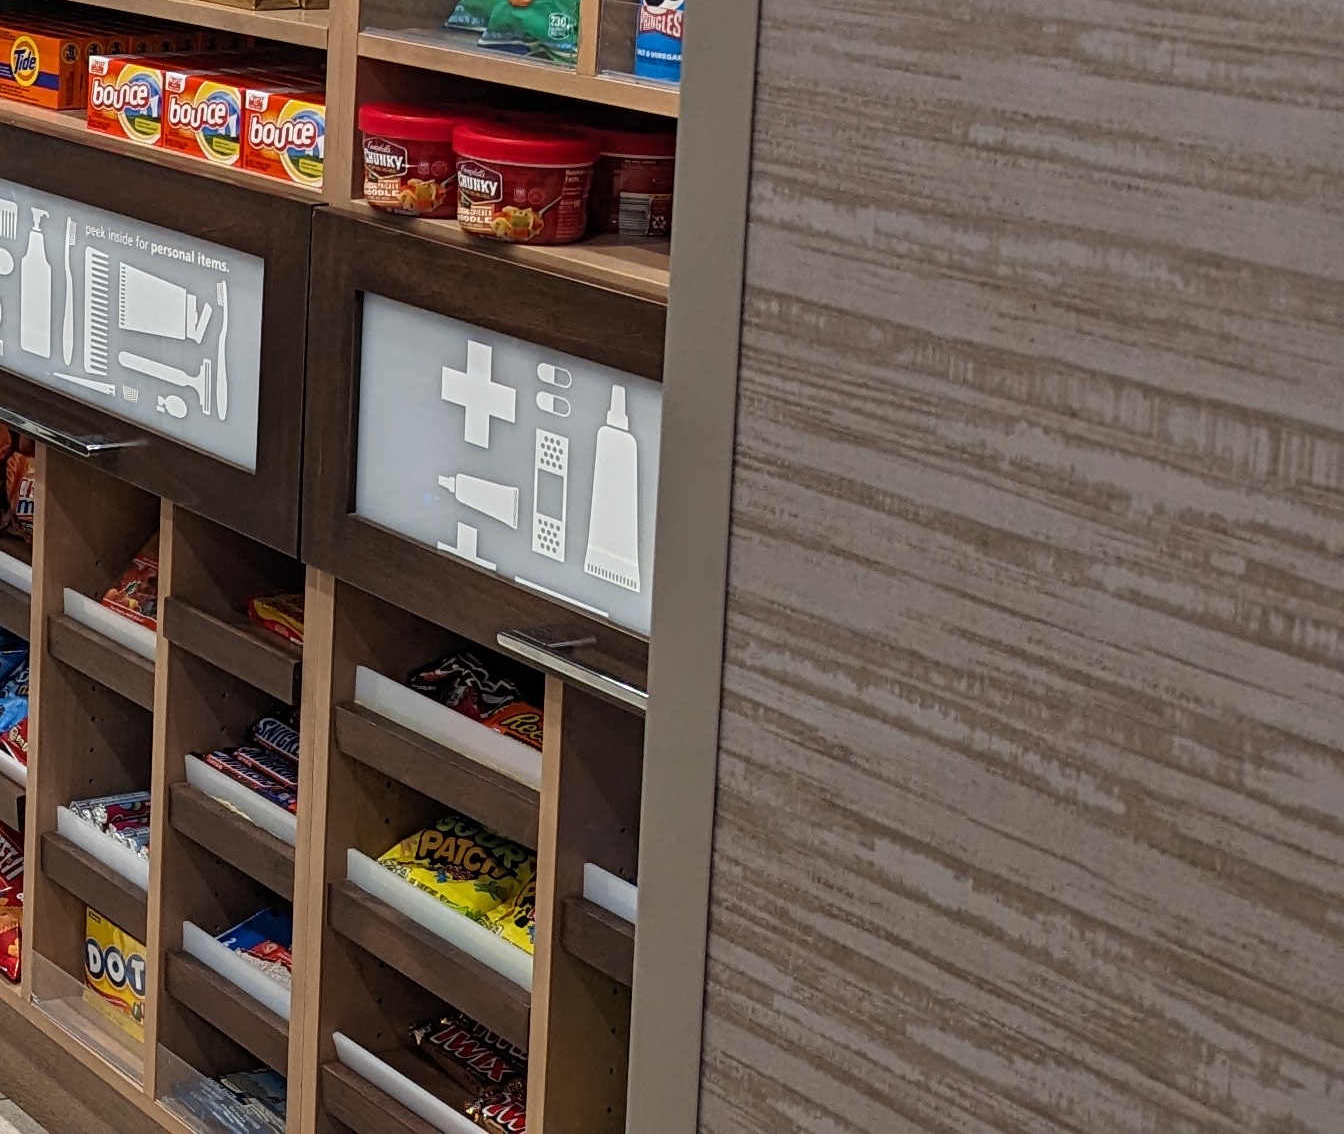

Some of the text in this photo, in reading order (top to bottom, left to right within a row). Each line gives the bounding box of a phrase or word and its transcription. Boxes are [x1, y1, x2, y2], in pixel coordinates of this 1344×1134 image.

[640, 9, 682, 37] PRINGLES
[13, 48, 37, 75] Tide
[92, 79, 149, 110] bounce
[169, 96, 228, 129] bounce
[250, 115, 316, 150] bounce
[364, 148, 403, 171] CHUNKY
[458, 172, 499, 196] CHUNKY
[86, 225, 230, 273] peek inside for personal items.
[430, 1026, 515, 1082] TWIX
